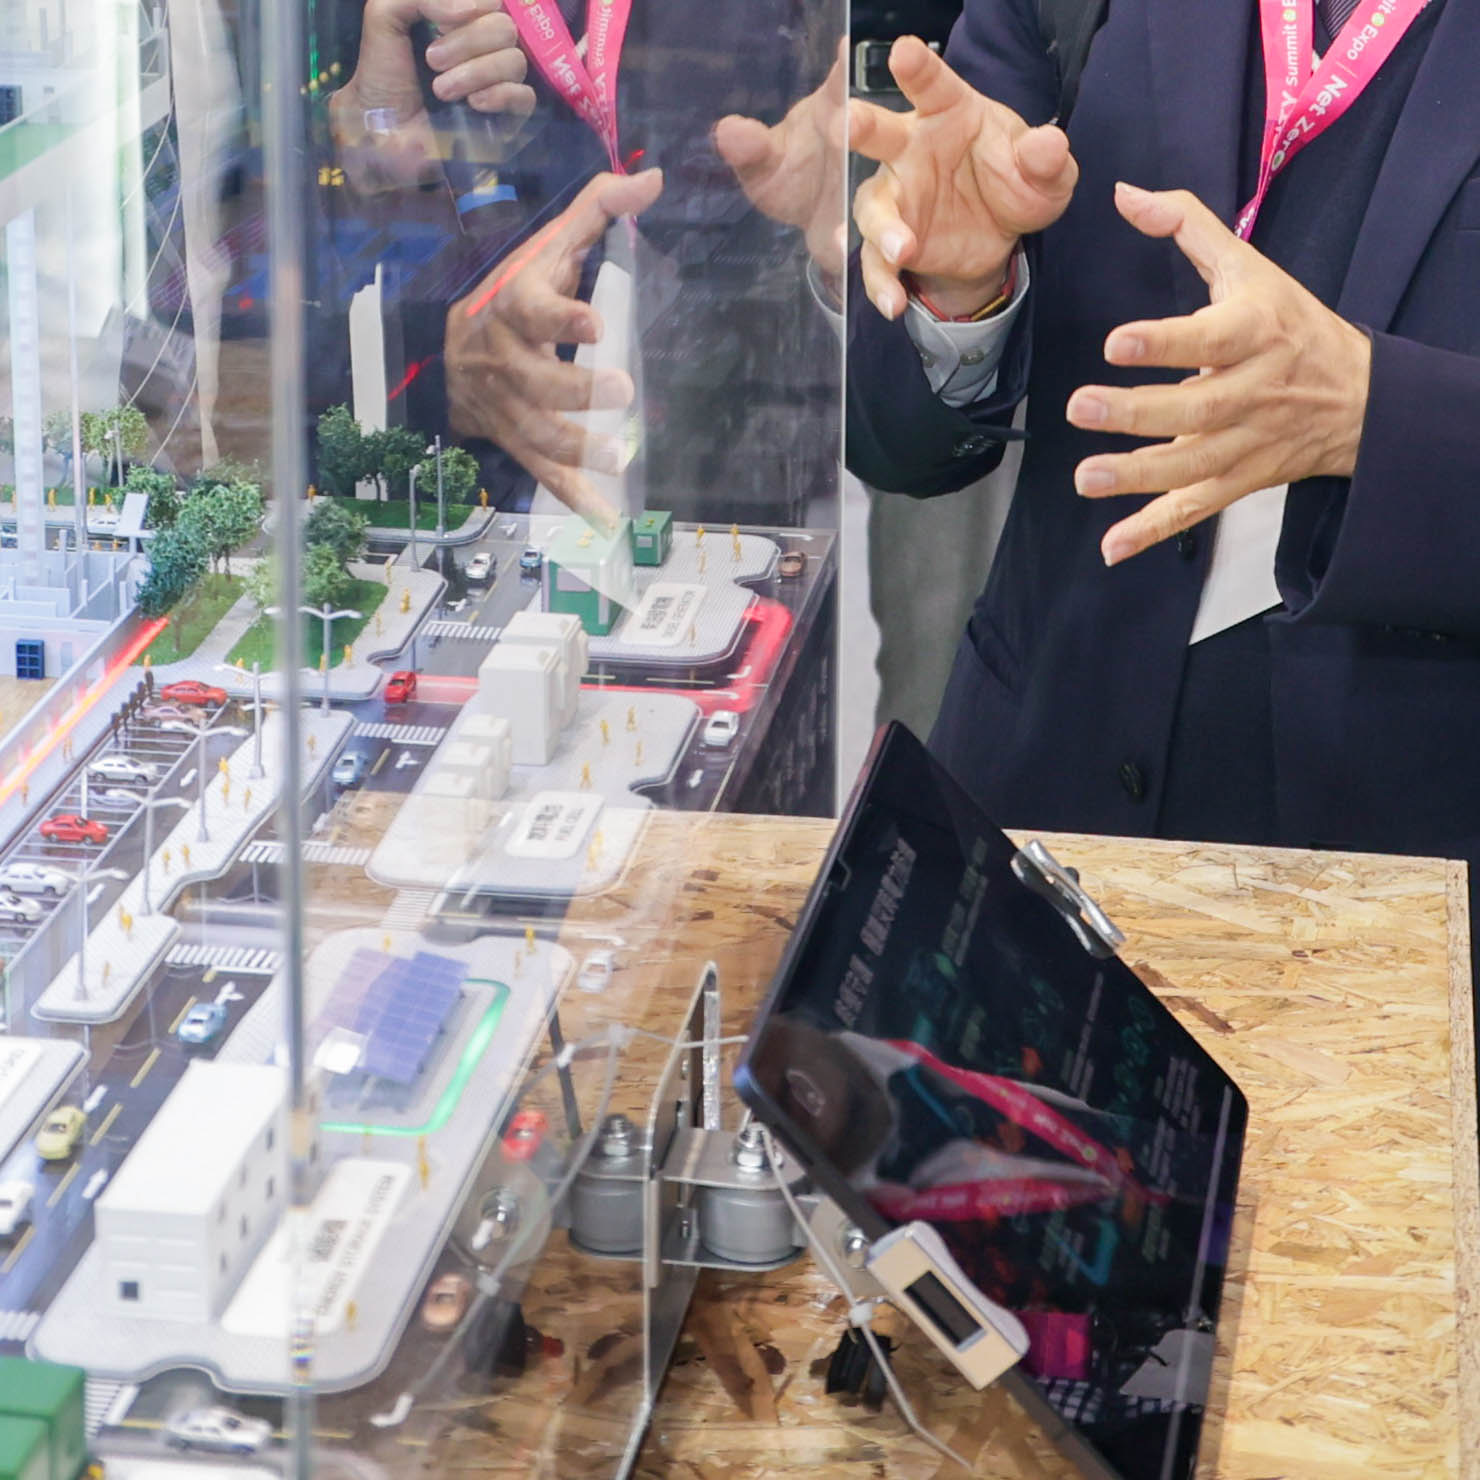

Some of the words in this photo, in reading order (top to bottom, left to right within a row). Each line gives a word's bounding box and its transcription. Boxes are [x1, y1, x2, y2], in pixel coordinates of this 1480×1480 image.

[1282, 24, 1299, 86] Summit
[1347, 24, 1380, 61] Expo
[1310, 74, 1348, 117] Net
